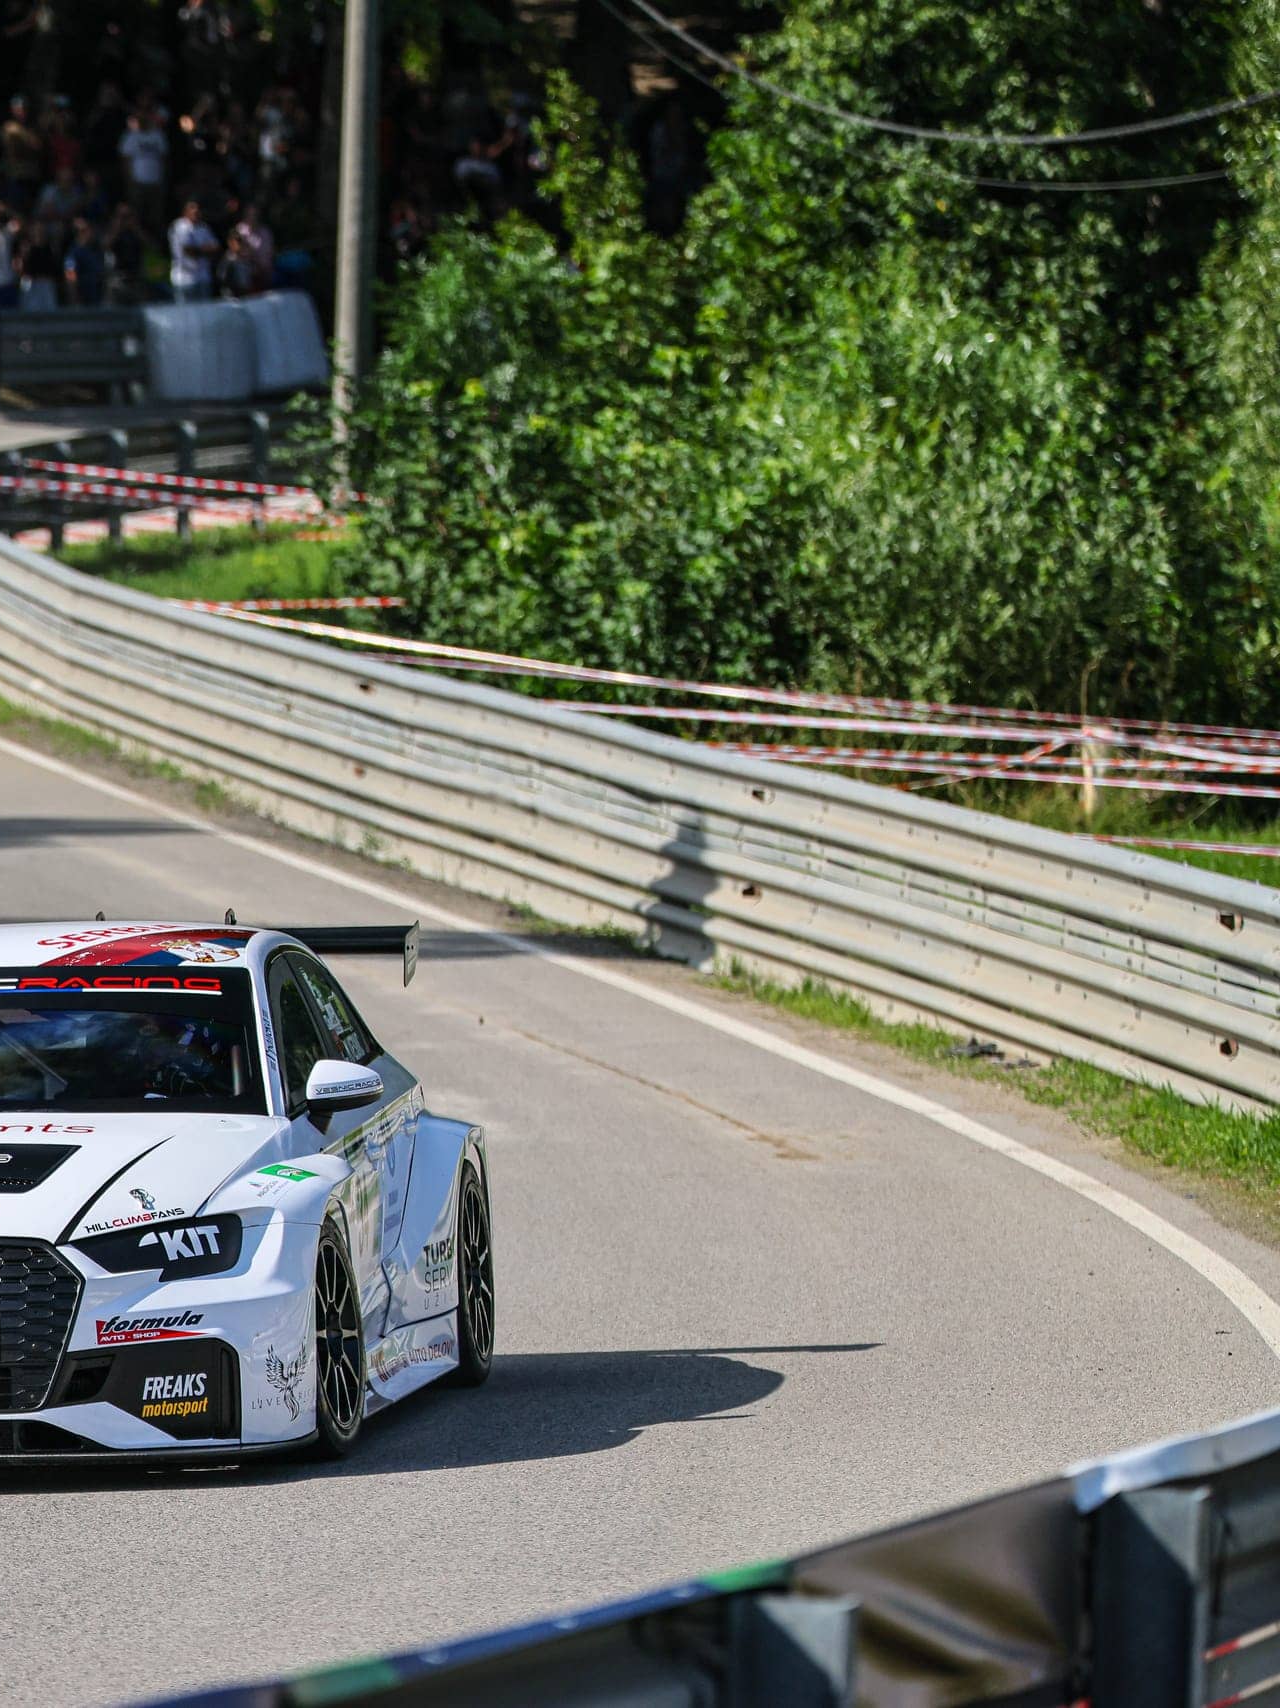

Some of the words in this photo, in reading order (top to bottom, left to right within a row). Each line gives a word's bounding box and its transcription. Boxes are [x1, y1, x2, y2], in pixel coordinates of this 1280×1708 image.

[85, 1208, 185, 1234] HILLCLIMBFANS
[423, 1238, 455, 1268] TURB
[101, 1310, 204, 1334] formula
[132, 1331, 160, 1340] SHOP
[142, 1373, 208, 1400] FREAKS
[142, 1397, 208, 1418] motorsport
